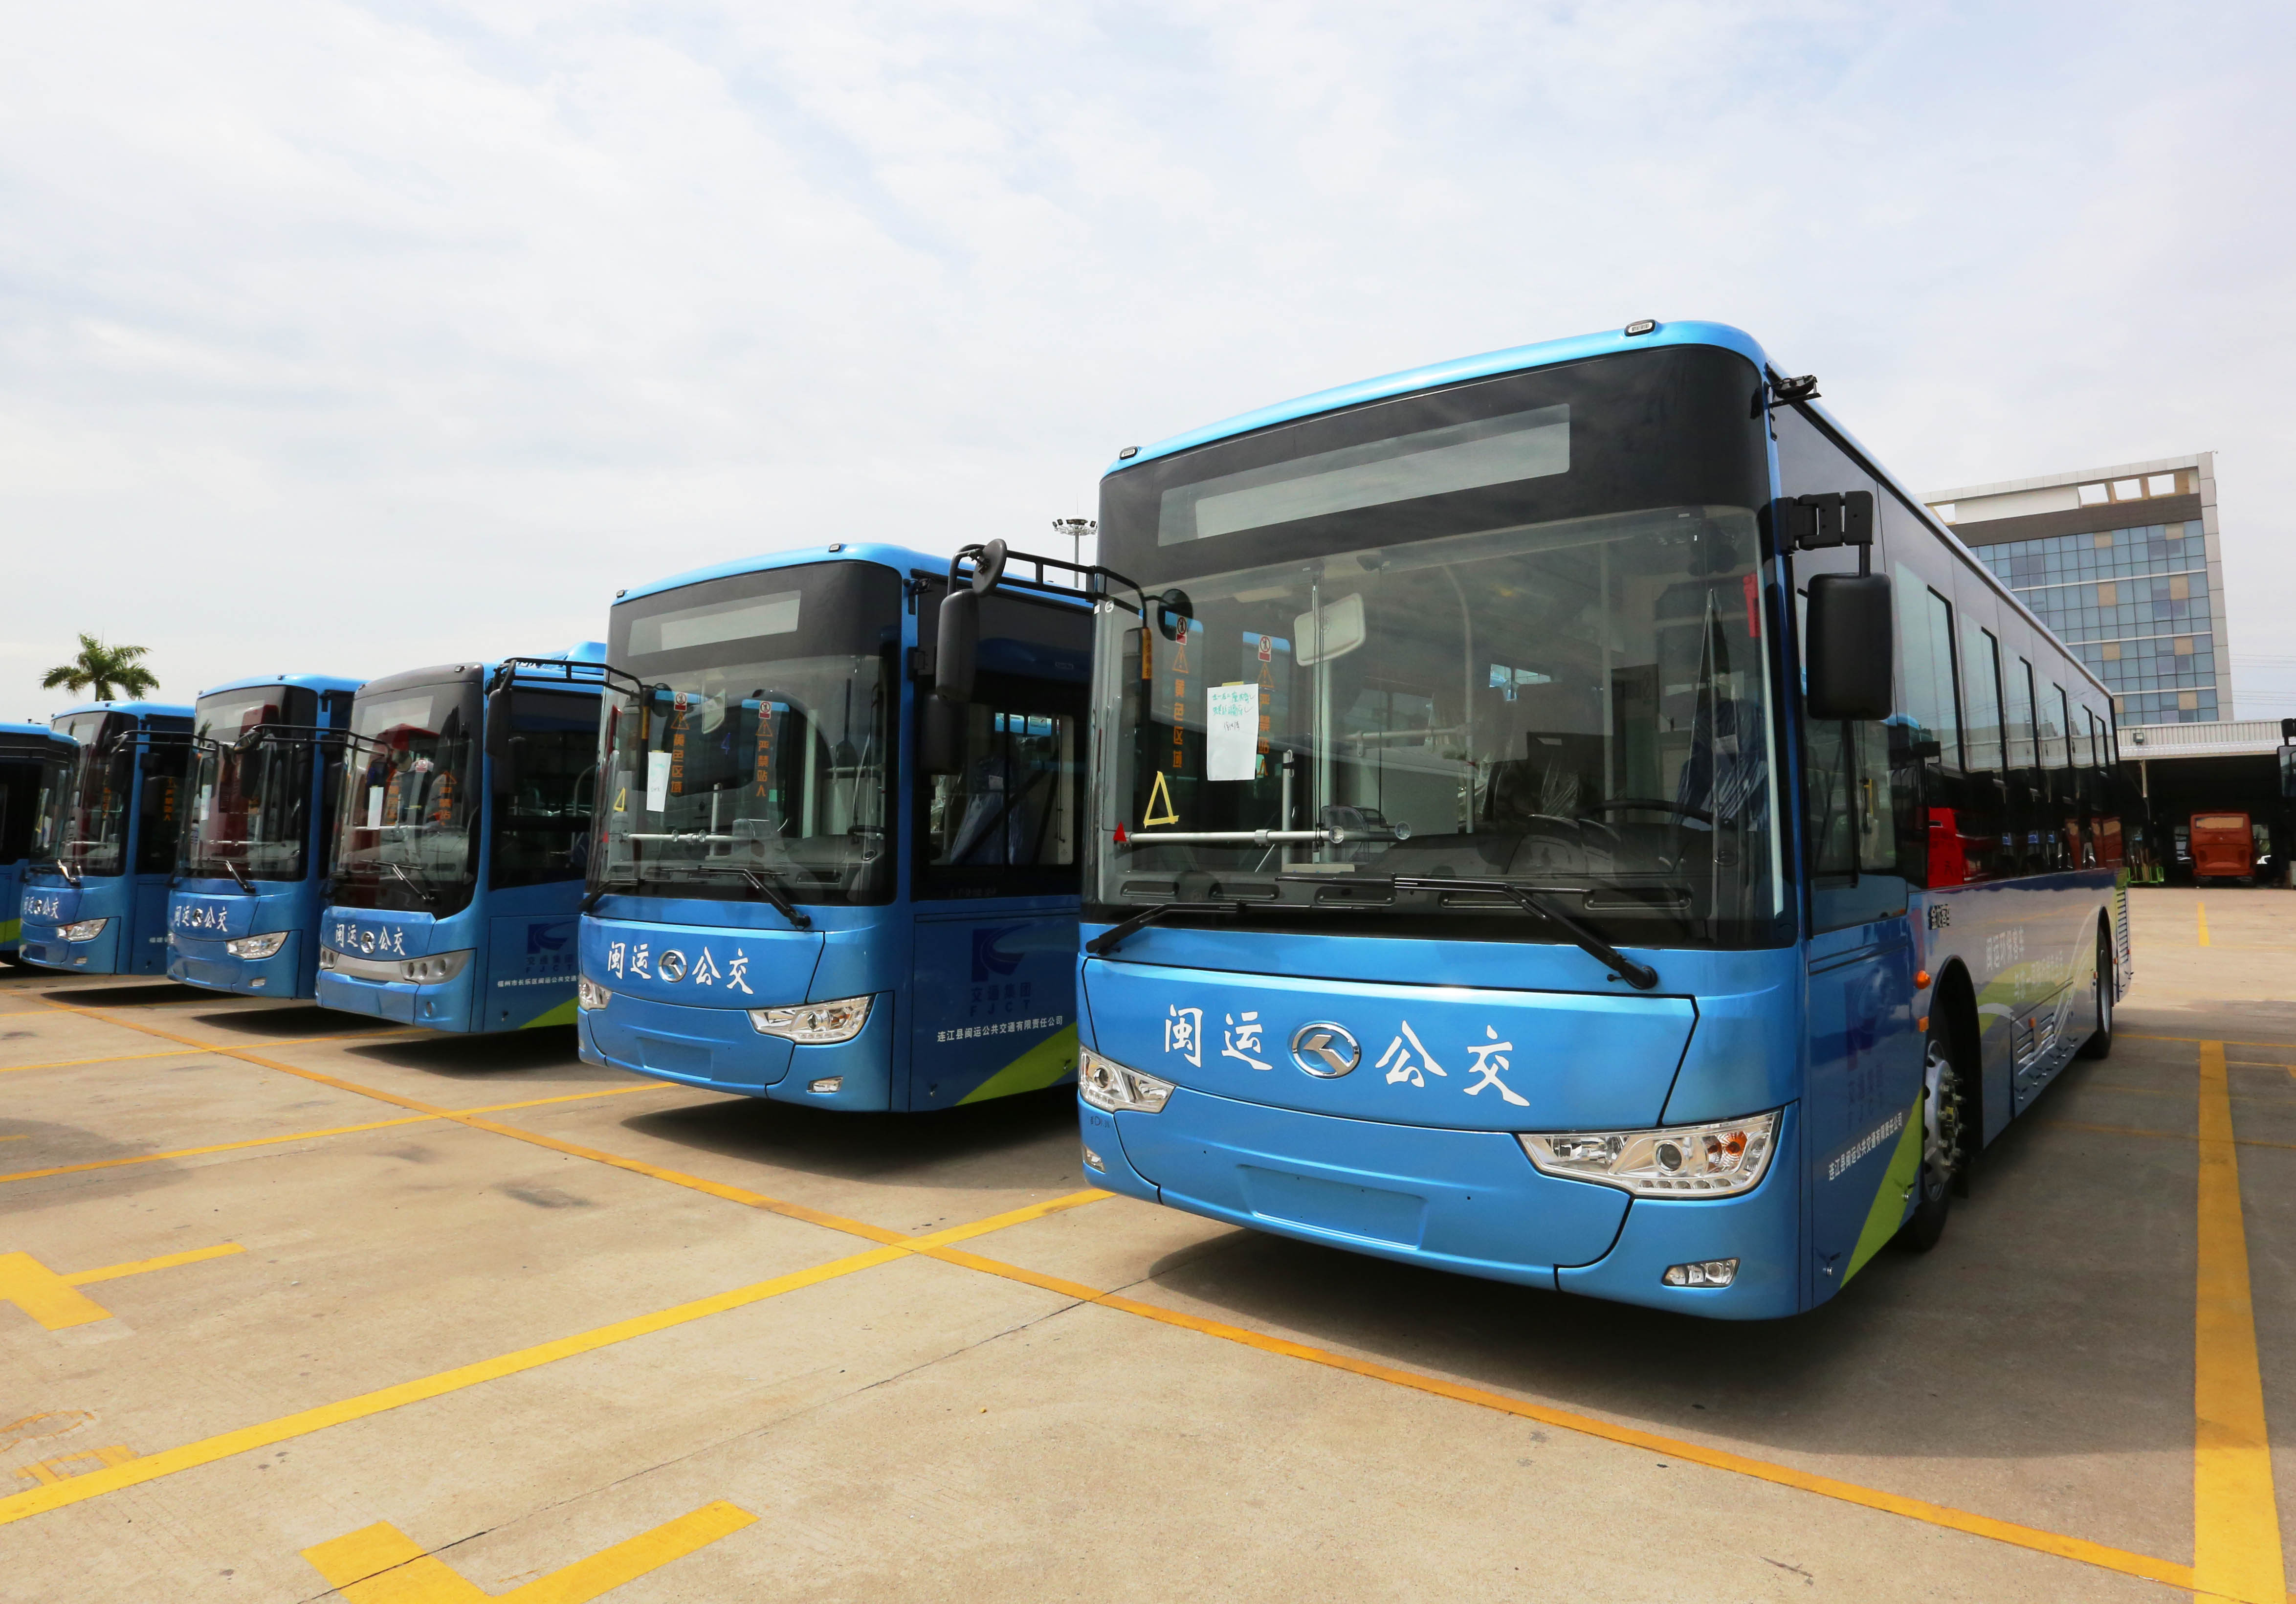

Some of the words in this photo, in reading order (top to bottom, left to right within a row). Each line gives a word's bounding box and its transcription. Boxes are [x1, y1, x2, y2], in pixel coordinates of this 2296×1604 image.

[1173, 679, 1185, 768] 黄色区域
[671, 734, 684, 793] 黄色区域
[755, 740, 769, 797] 严禁站人
[42, 897, 59, 919] 公交
[175, 905, 190, 928] 闽运
[204, 905, 228, 933] 公交
[335, 924, 358, 948] 闽运
[378, 926, 406, 956] 公交
[497, 975, 579, 988] 福州市长乐区闽运公共交通
[607, 941, 652, 980] 闽运
[692, 946, 754, 995] 公交
[971, 982, 1032, 1003] 交通集团
[937, 1016, 1063, 1042] 连江县闽运公共交通有限责任公司
[1165, 1004, 1273, 1072] 闽运
[1375, 1020, 1530, 1107] 公交
